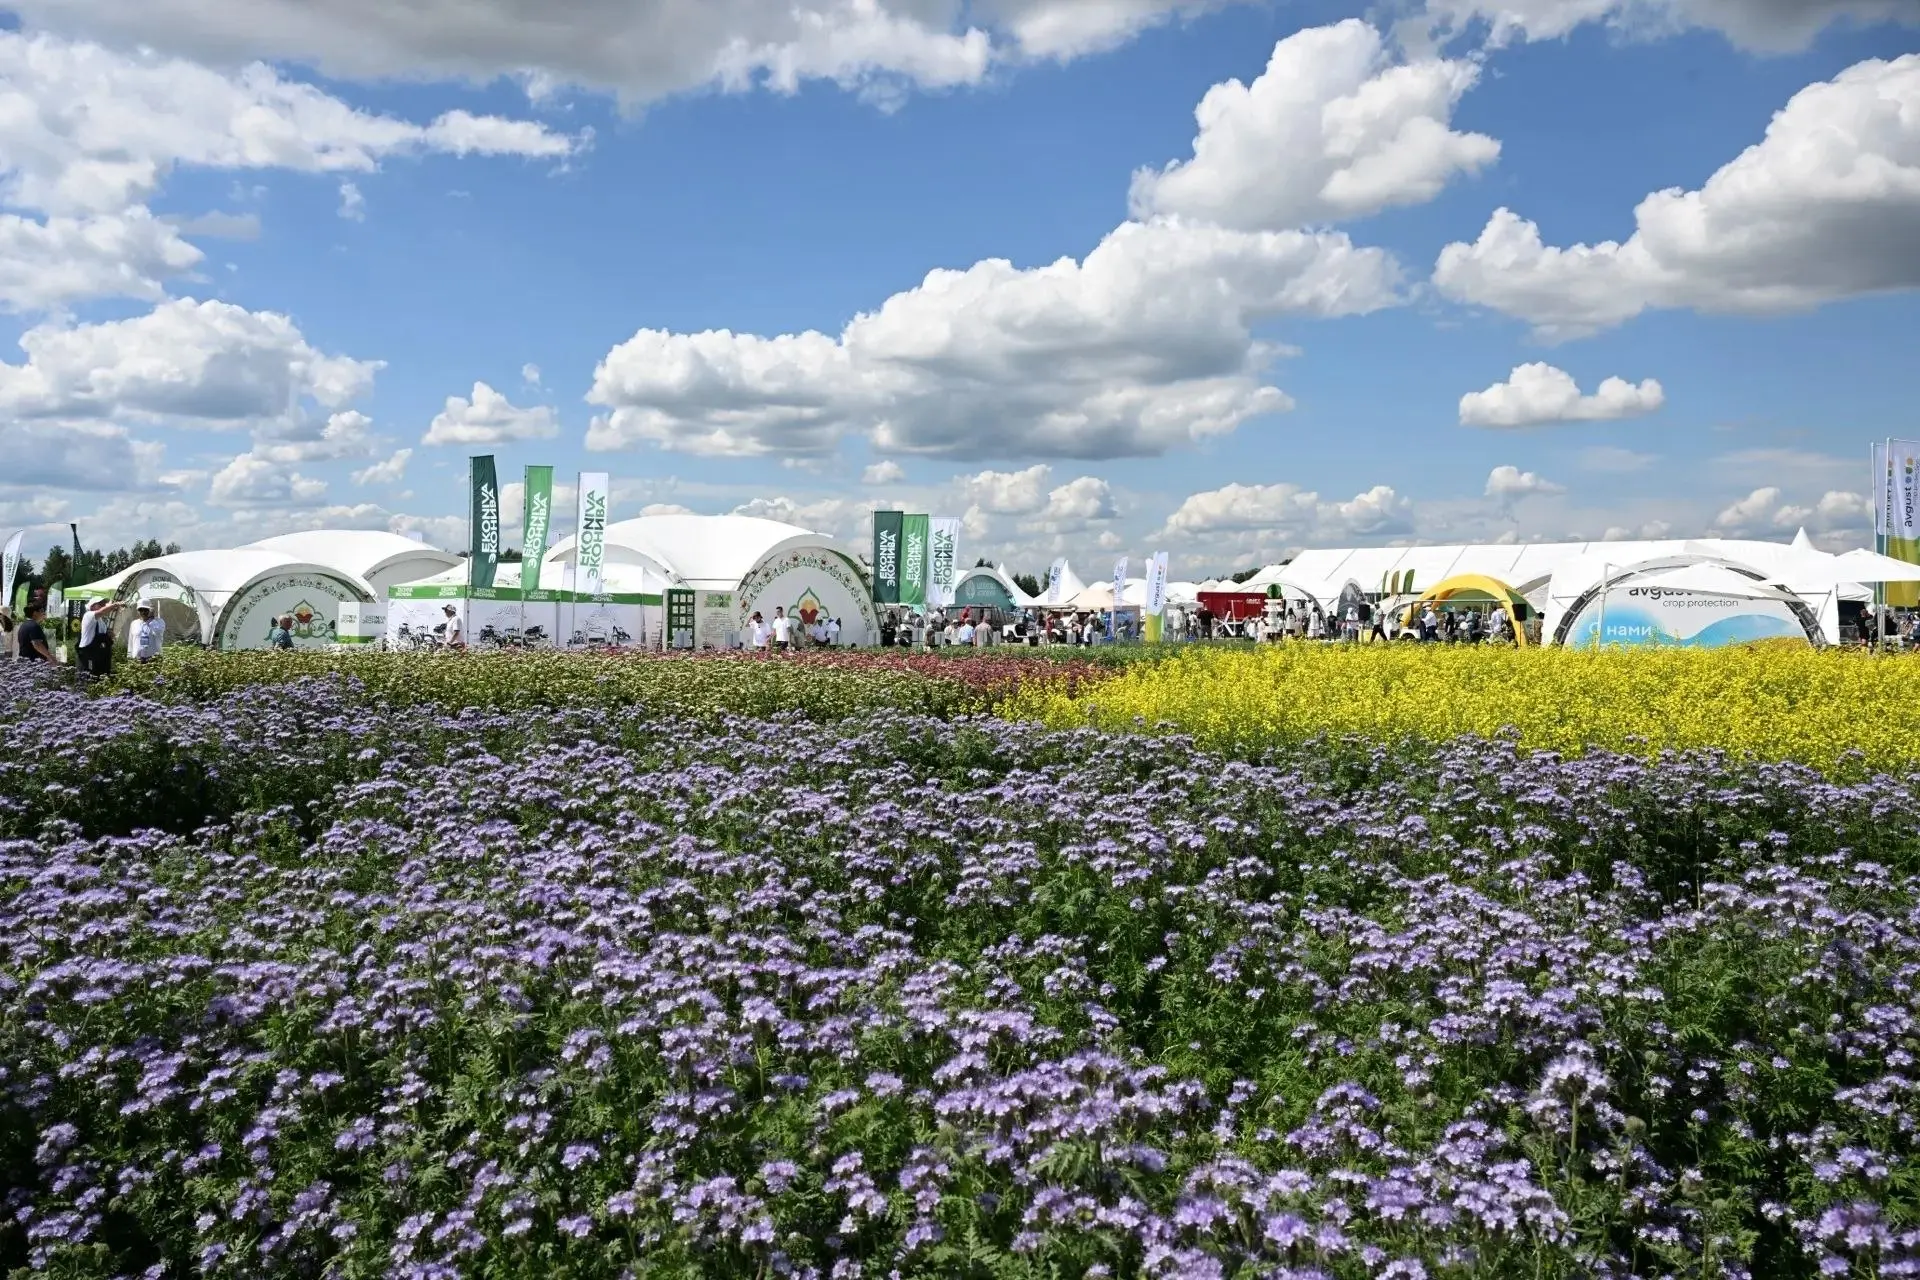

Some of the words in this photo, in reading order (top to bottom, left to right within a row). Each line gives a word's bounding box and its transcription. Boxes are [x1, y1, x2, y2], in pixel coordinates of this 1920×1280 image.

[482, 483, 491, 553] EKONIVA
[488, 488, 498, 564] ЭКОНИВА
[522, 492, 542, 558] EKONIVA
[527, 496, 548, 569] ЭКОНИВА
[580, 490, 595, 566] EKONIVA
[1904, 486, 1914, 528] avgust
[587, 495, 605, 579] ЭКОНИВА
[880, 530, 889, 580] EKONIVA
[887, 533, 896, 587] ЭКОНИВА
[906, 532, 916, 581] EKONIVA
[933, 529, 944, 585] EKONIVA
[942, 534, 954, 594] ЭКОНИВА
[1629, 587, 1692, 600] avgu
[1662, 600, 1685, 609] crop
[1688, 599, 1739, 608] protection
[1607, 625, 1652, 636] нами
